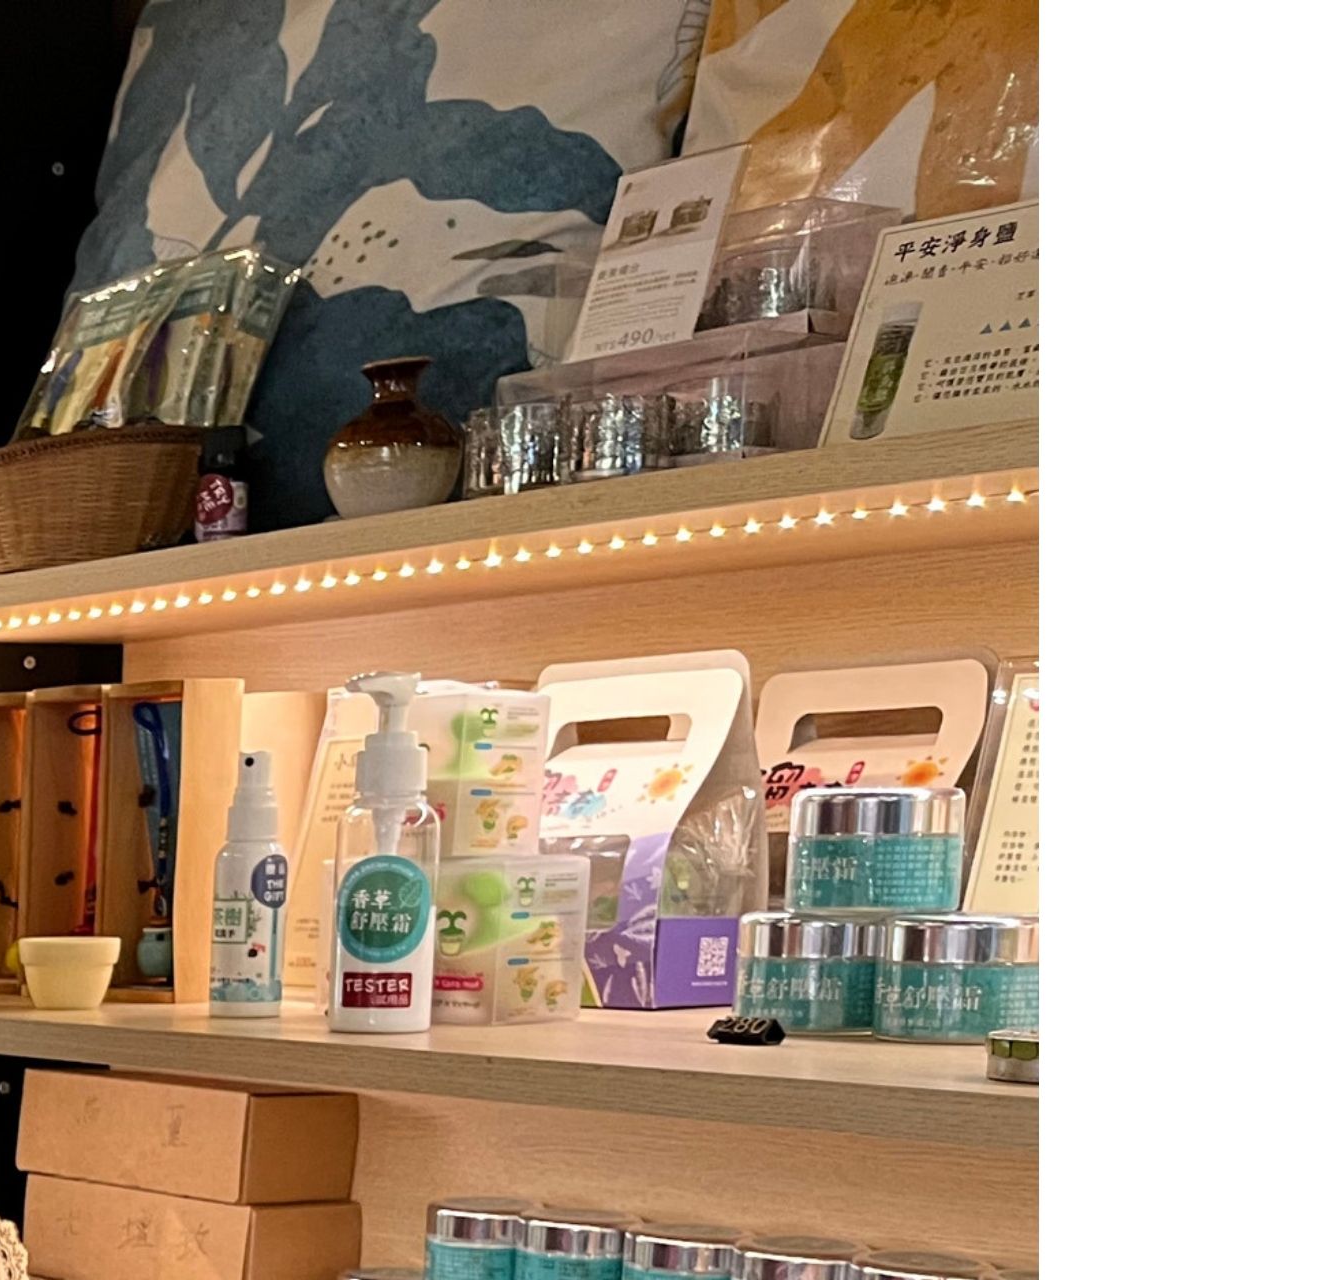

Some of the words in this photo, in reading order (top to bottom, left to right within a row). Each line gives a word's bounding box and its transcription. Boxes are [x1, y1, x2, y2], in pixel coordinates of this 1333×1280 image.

[894, 221, 1018, 262] 平安淨身鹽
[351, 888, 393, 910] 香草
[345, 977, 410, 993] TESTER
